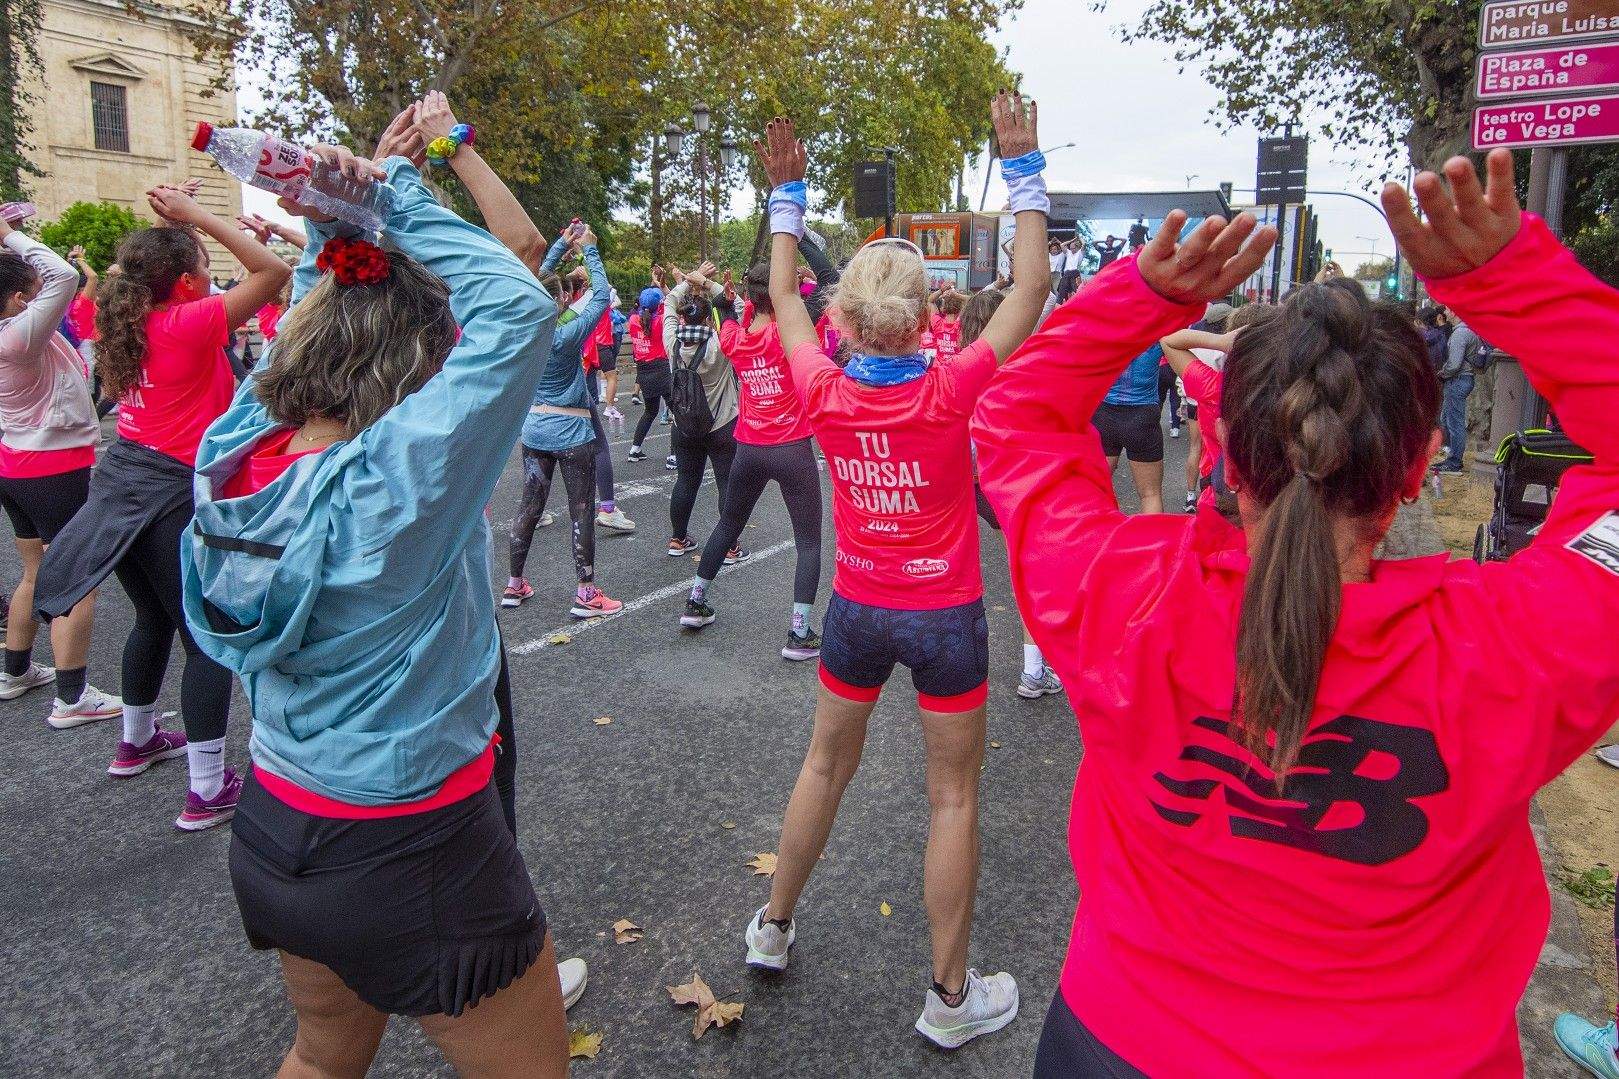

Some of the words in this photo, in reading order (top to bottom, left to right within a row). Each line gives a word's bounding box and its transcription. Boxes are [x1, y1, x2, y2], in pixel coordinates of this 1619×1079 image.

[1491, 1, 1568, 24] parque
[1561, 15, 1619, 33] Luisa
[1486, 57, 1546, 74] Plaza
[1559, 52, 1588, 68] de
[1485, 69, 1569, 91] España
[1482, 110, 1535, 126] teatro
[1544, 104, 1601, 122] Lope
[1481, 127, 1508, 143] de
[1520, 123, 1576, 139] Vega
[740, 366, 784, 383] DORSAL
[749, 381, 783, 397] SUMA
[855, 431, 891, 459] TU
[833, 455, 930, 488] DORSAL
[849, 485, 921, 515] SUMA
[867, 518, 900, 533] 2024
[835, 550, 874, 571] OYSHO
